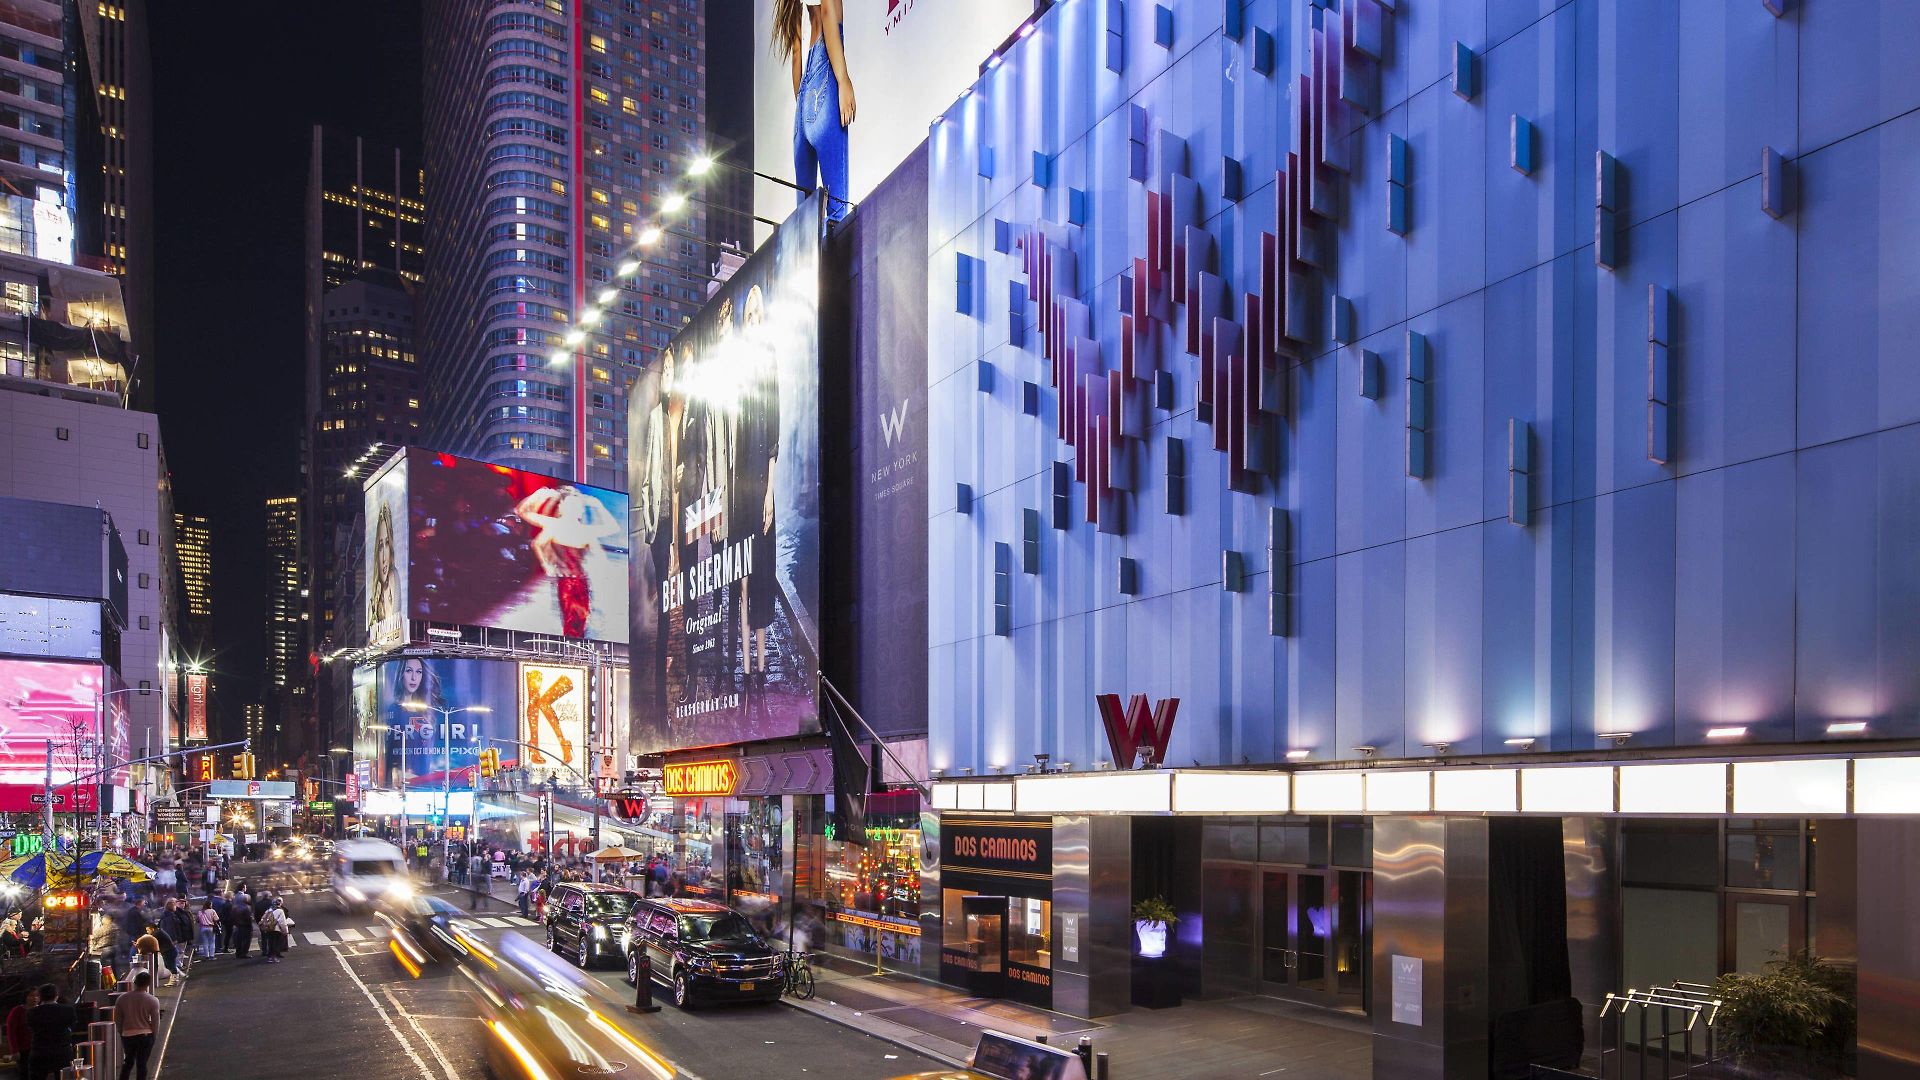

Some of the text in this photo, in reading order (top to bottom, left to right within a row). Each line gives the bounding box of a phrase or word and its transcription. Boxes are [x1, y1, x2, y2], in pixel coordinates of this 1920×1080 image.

[880, 399, 909, 448] W
[872, 451, 917, 483] NEW YORK
[875, 476, 914, 501] TIMES SQUARE
[662, 538, 753, 613] BEN SHERMAN
[686, 604, 723, 635] Original
[692, 643, 704, 654] Since
[1095, 693, 1181, 770] W
[667, 763, 729, 793] DOS CAMINOS
[624, 799, 644, 818] W
[955, 835, 1038, 862] DOS CAMINOS
[943, 953, 978, 969] DOS CAMINOS
[1401, 963, 1413, 973] W
[1008, 967, 1050, 986] DOS CAMINOS
